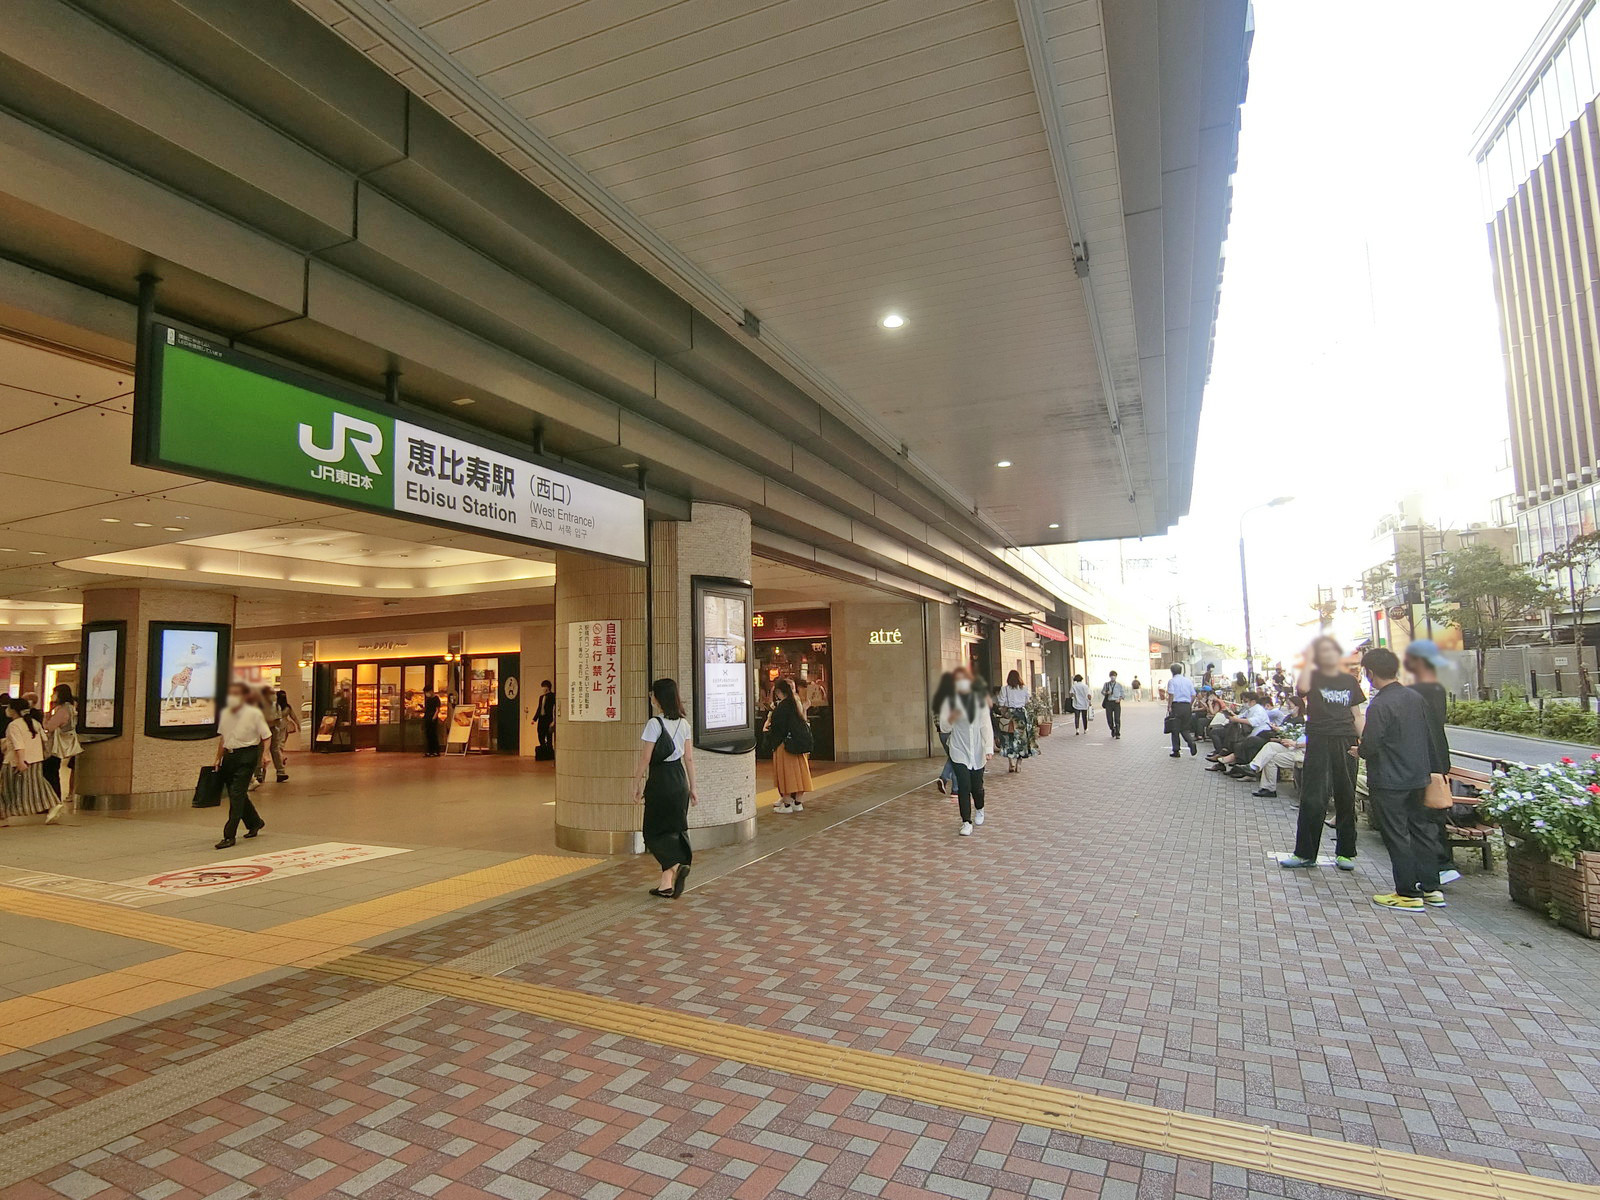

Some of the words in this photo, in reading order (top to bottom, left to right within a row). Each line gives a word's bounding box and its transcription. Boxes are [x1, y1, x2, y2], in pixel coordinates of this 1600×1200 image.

[298, 412, 383, 476] JR
[311, 464, 374, 490] JR東日本
[406, 437, 516, 500] 恵比寿駅
[406, 480, 457, 510] Ebisu
[462, 495, 517, 524] Station
[530, 500, 555, 519] (West
[557, 508, 595, 529] Entrance)
[530, 516, 553, 532] 西入口
[574, 527, 588, 540] 입구
[868, 628, 903, 644] atré
[592, 635, 603, 692] 走行禁止
[605, 623, 617, 719] 自転車・スケボー等
